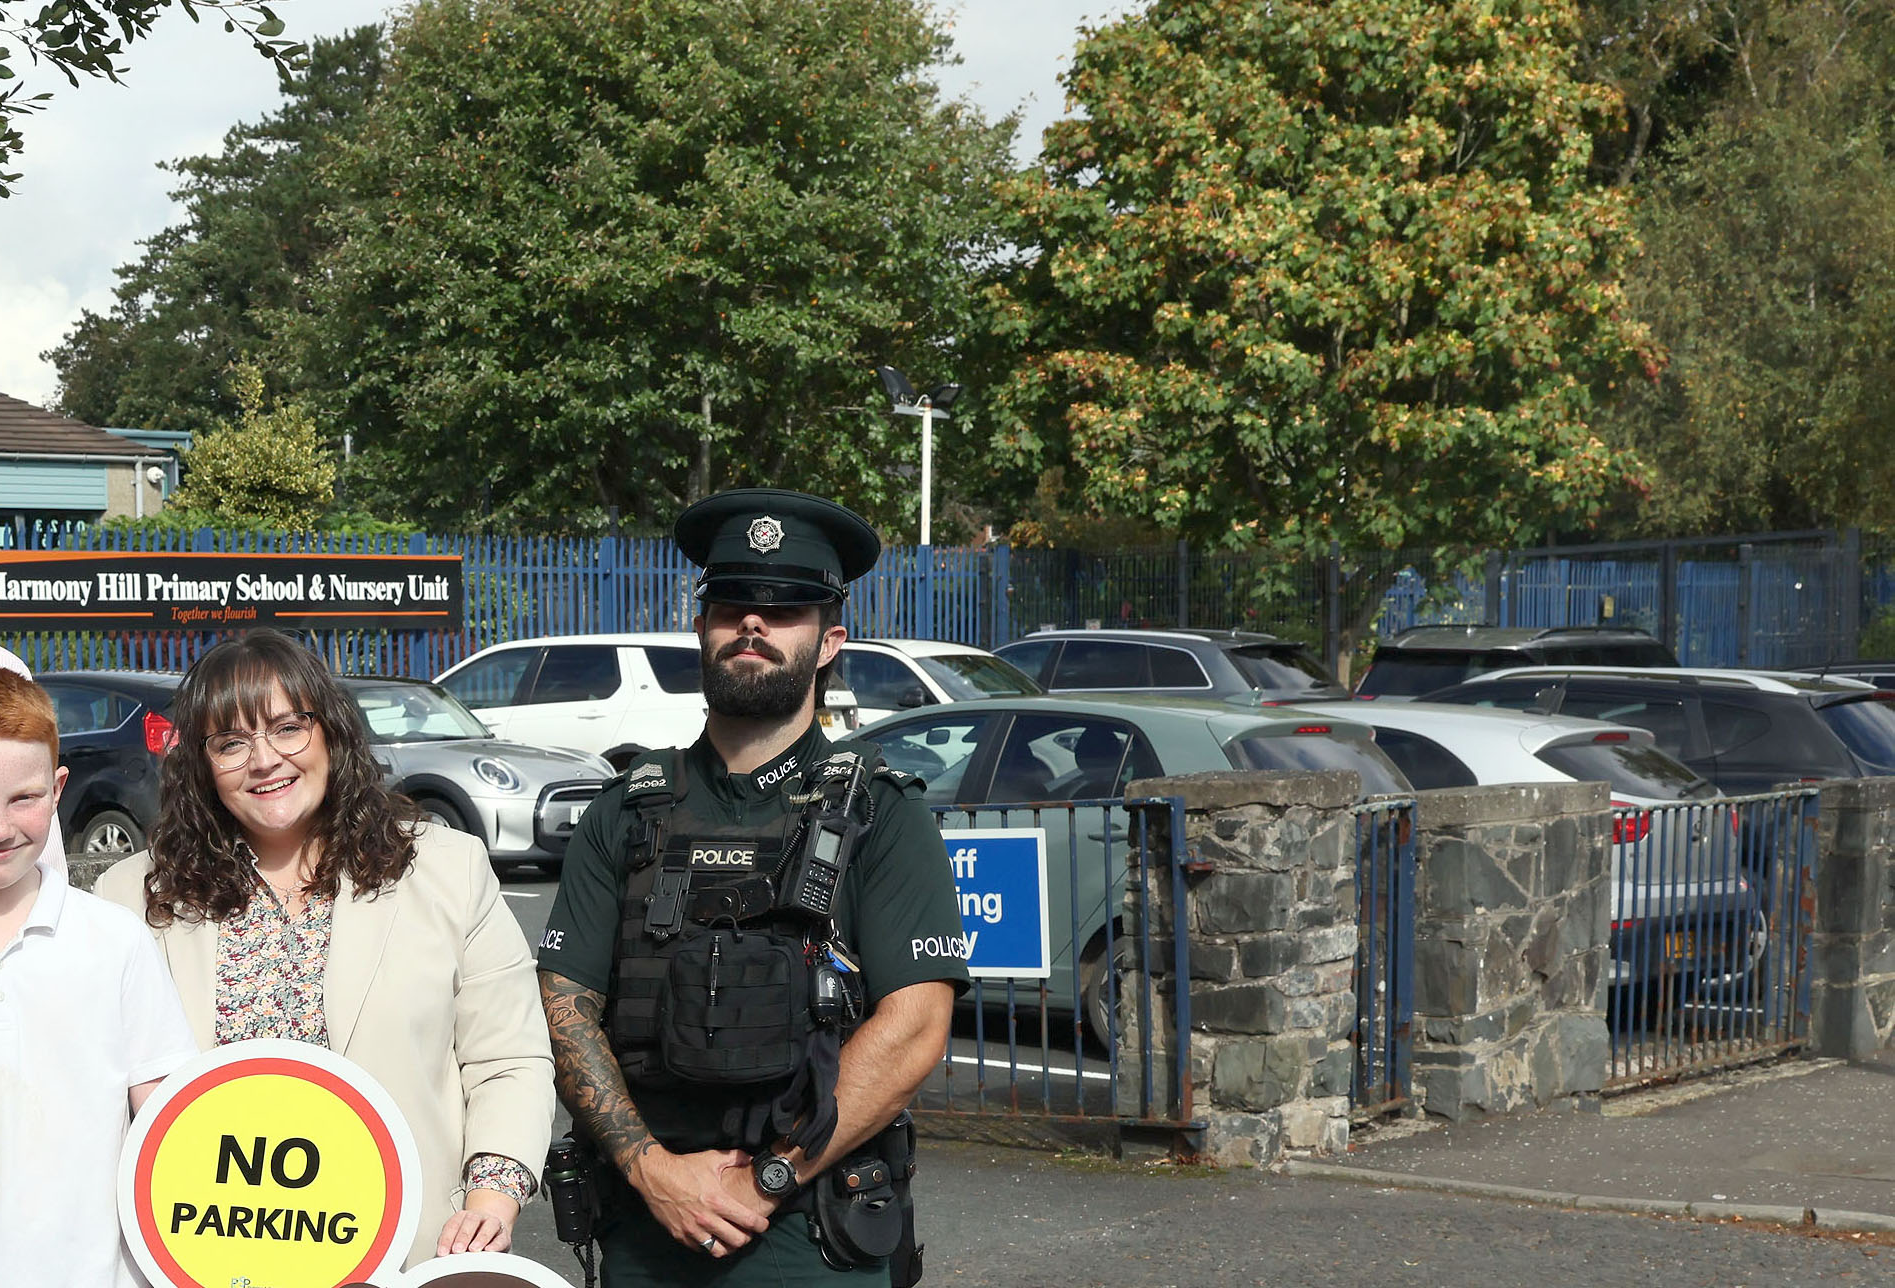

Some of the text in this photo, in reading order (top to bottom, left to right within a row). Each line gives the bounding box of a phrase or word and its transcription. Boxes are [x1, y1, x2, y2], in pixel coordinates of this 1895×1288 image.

[96, 572, 142, 601] Hill
[145, 573, 232, 606] Primary
[235, 573, 305, 601] School
[308, 574, 326, 601] &
[329, 574, 405, 606] Nursery
[407, 574, 450, 601] Unit
[171, 606, 257, 623] Together we flourish
[628, 778, 667, 793] 25092
[757, 755, 798, 790] POLICE
[691, 850, 755, 866] POLICE
[949, 848, 978, 879] ff
[911, 935, 967, 961] POLICE
[215, 1134, 321, 1189] NO
[170, 1202, 359, 1245] PARKING
